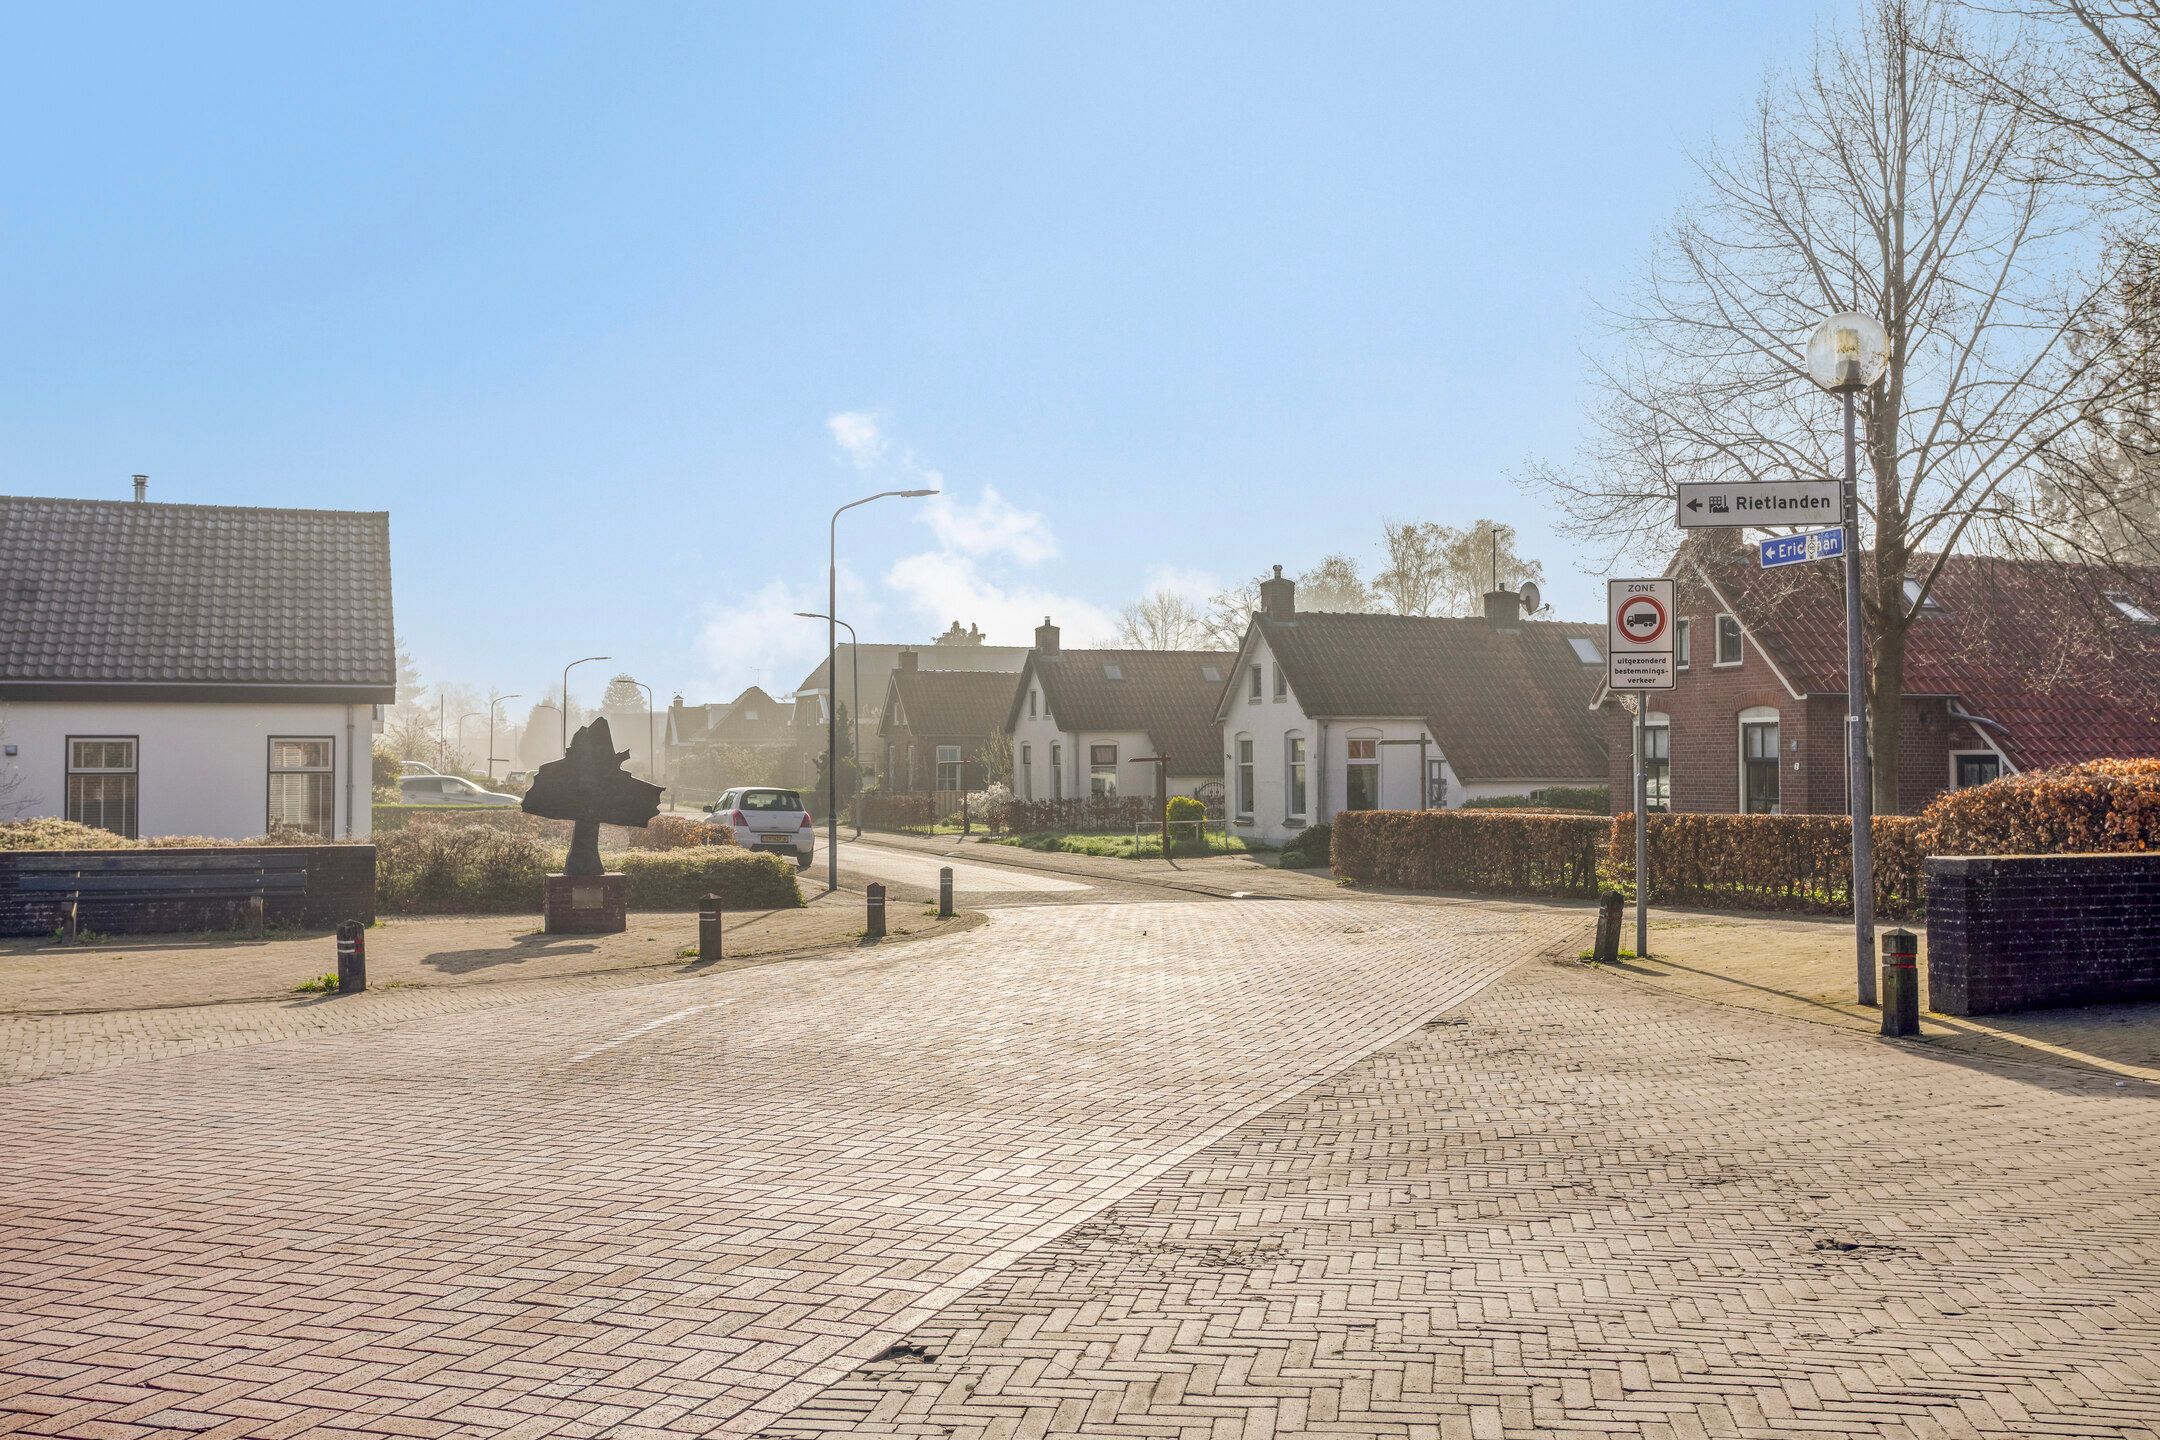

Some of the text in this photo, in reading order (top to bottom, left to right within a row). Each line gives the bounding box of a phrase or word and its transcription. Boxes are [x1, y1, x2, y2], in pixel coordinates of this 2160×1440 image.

[1736, 494, 1831, 511] Rietlanden
[1627, 584, 1656, 593] ZONE
[1617, 657, 1667, 666] uitgezonderd
[1614, 667, 1669, 676] bestemmings-
